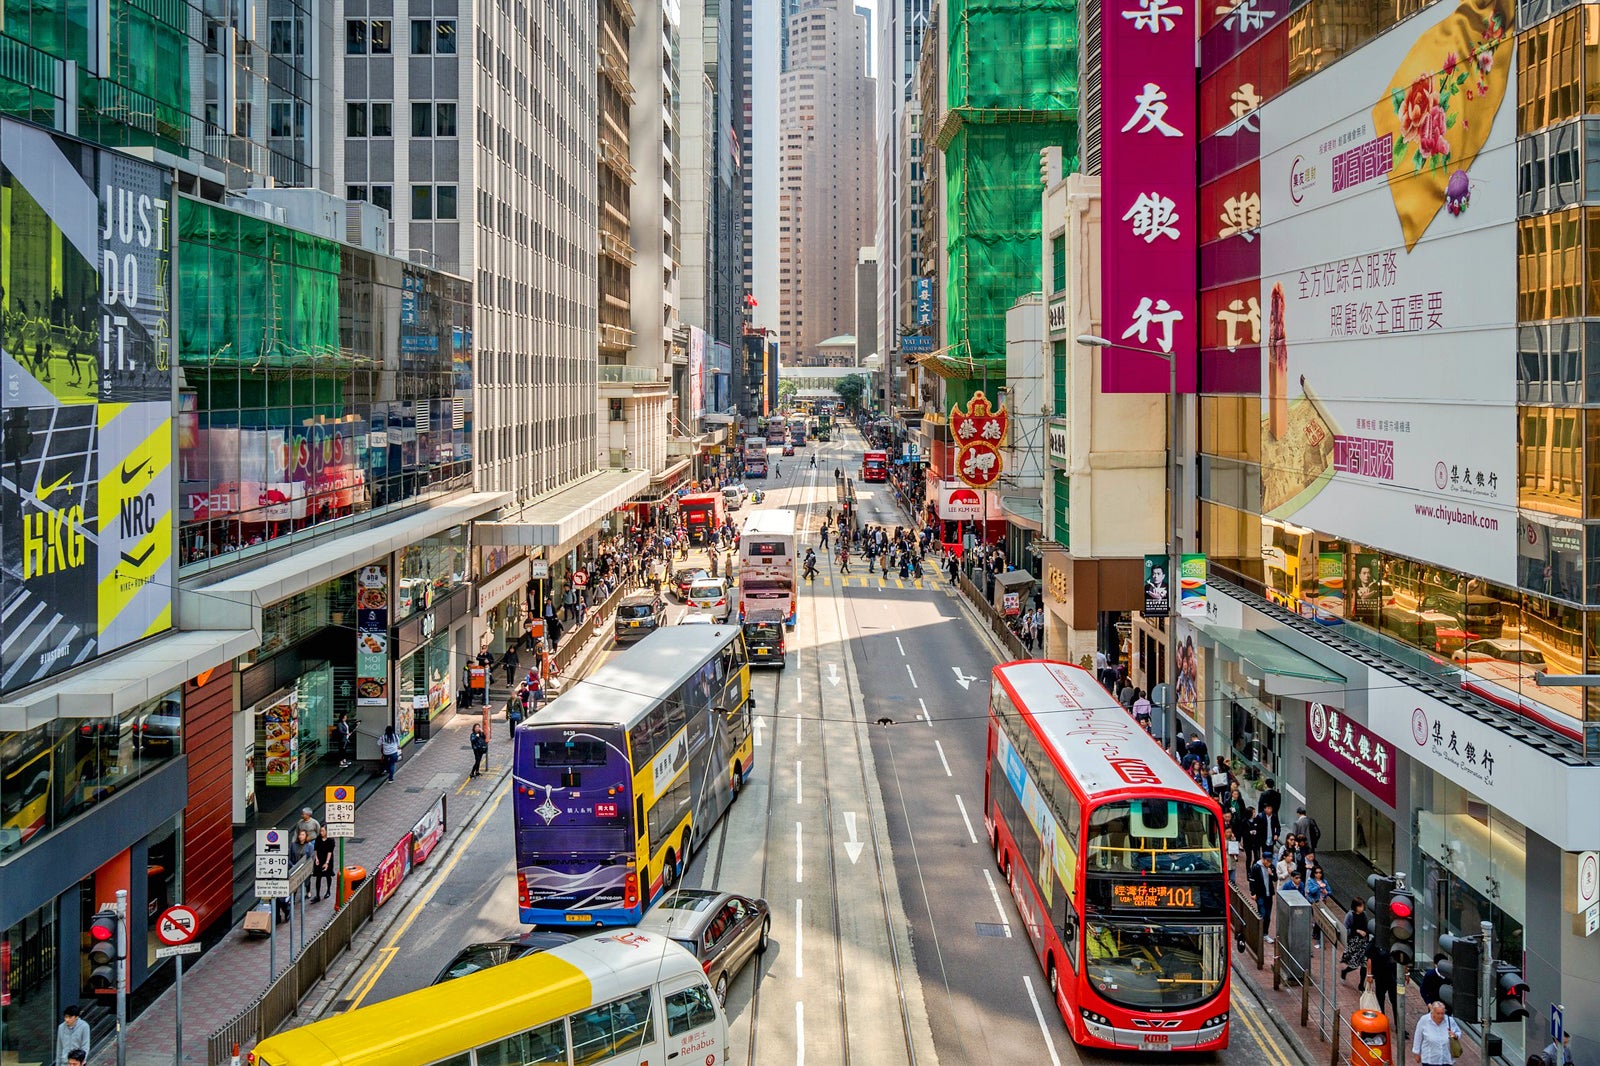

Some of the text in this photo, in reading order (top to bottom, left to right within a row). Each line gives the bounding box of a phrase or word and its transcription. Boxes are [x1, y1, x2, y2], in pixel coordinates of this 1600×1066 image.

[1332, 133, 1392, 193] 財富管理
[103, 184, 168, 249] JUST
[103, 249, 138, 308] DO
[1298, 252, 1397, 300] 全方位綜合服務
[1330, 291, 1443, 336] 照顧您全面需要
[1333, 436, 1394, 480] 工商服務
[1450, 464, 1498, 490] 集友銀行
[120, 493, 155, 540] NRC
[1414, 503, 1499, 531] www.chiyubank.com
[23, 504, 85, 581] HKG
[1328, 711, 1388, 774] 集友銀行
[1432, 720, 1494, 776] 集友銀行
[336, 804, 353, 812] 8-10
[268, 857, 287, 865] 8-10
[1166, 887, 1195, 907] 101
[680, 1038, 715, 1057] Rehabus
[1143, 1033, 1169, 1044] KMB
